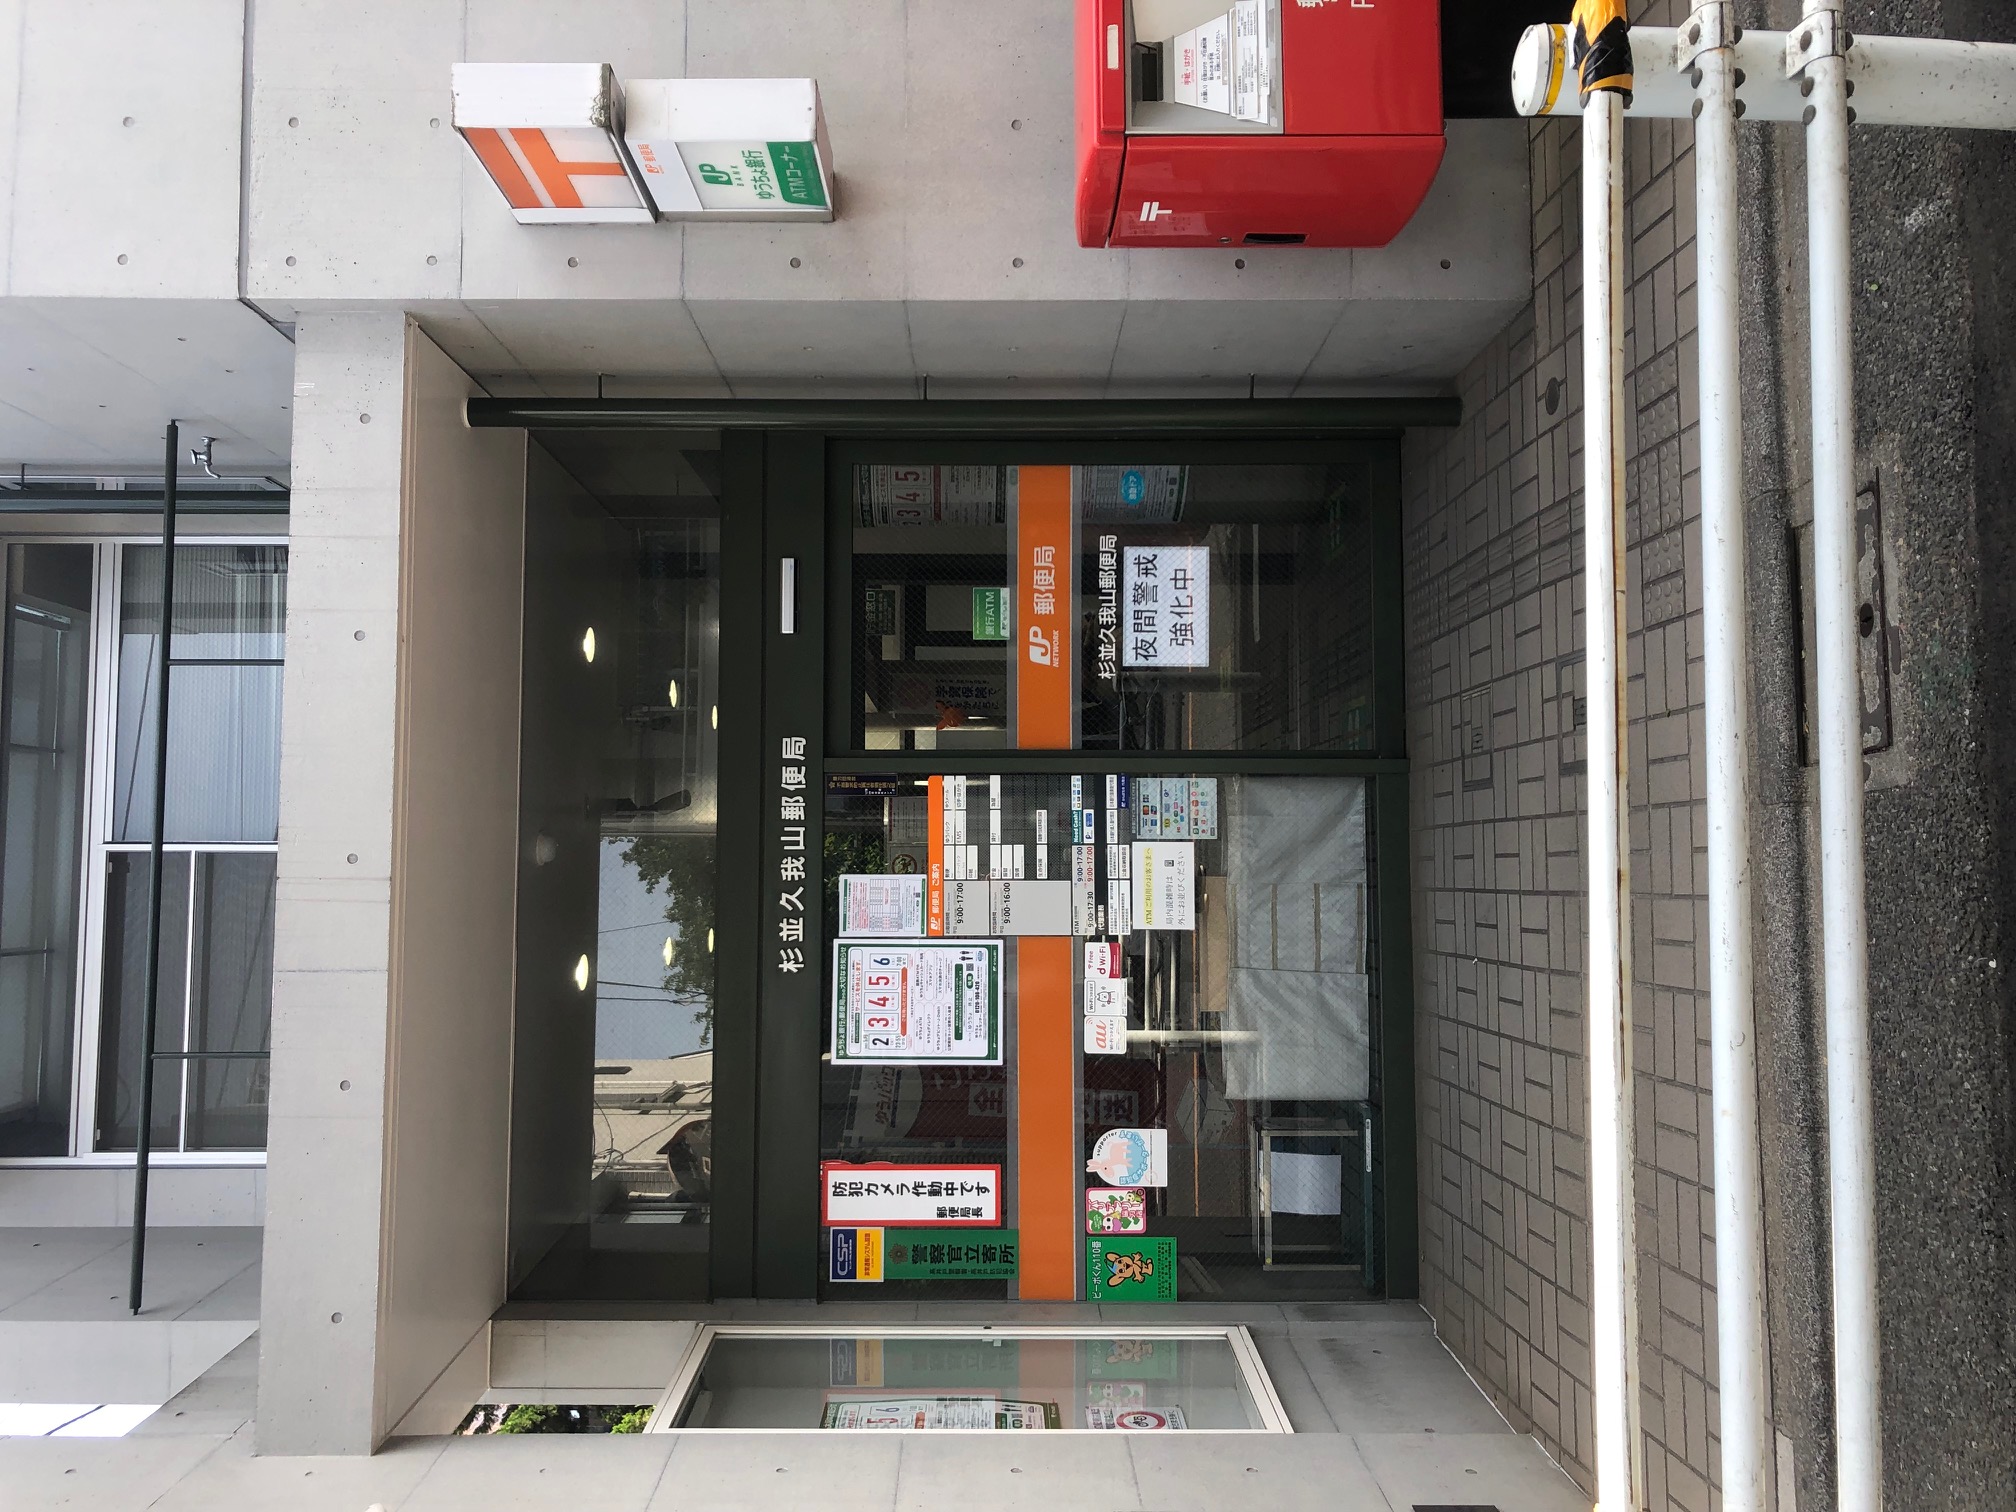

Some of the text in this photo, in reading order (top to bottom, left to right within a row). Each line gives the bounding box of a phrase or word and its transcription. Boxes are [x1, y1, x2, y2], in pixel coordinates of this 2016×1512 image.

[1183, 48, 1191, 86] 手紙・はがき
[730, 164, 744, 187] BANK
[741, 149, 775, 200] ゆうちょ銀行
[780, 145, 809, 199] ATMコーナー
[894, 470, 920, 482] 5
[895, 492, 920, 502] 4
[896, 509, 921, 517] 3
[1033, 545, 1056, 616] 郵便局
[985, 591, 995, 635] 銀行ATM
[1098, 534, 1118, 680] 杉並久我山郵便局
[1132, 553, 1159, 662] 夜間警戒
[1169, 568, 1195, 647] 強化中
[1051, 629, 1060, 668] NETWORK
[778, 735, 807, 973] 杉並久我山郵便局
[931, 863, 940, 886] ご案内
[1177, 850, 1186, 925] 外にお並びください
[931, 890, 940, 914] 郵便局
[1164, 875, 1173, 925] 局内混雑時は
[873, 957, 890, 966] 6
[1098, 946, 1106, 966] Wi-Fi
[868, 976, 890, 986] 5
[868, 996, 889, 1007] 4
[868, 1018, 889, 1027] 3
[1095, 1020, 1107, 1049] au
[872, 1038, 889, 1046] 2
[1096, 1131, 1118, 1156] supporter
[832, 1180, 991, 1198] 防犯カメラ作動中です
[936, 1206, 983, 1219] 郵便局長
[1087, 1199, 1141, 1212] バリアフリー
[837, 1233, 848, 1276] CSP
[911, 1243, 1015, 1265] 警察官立寄所
